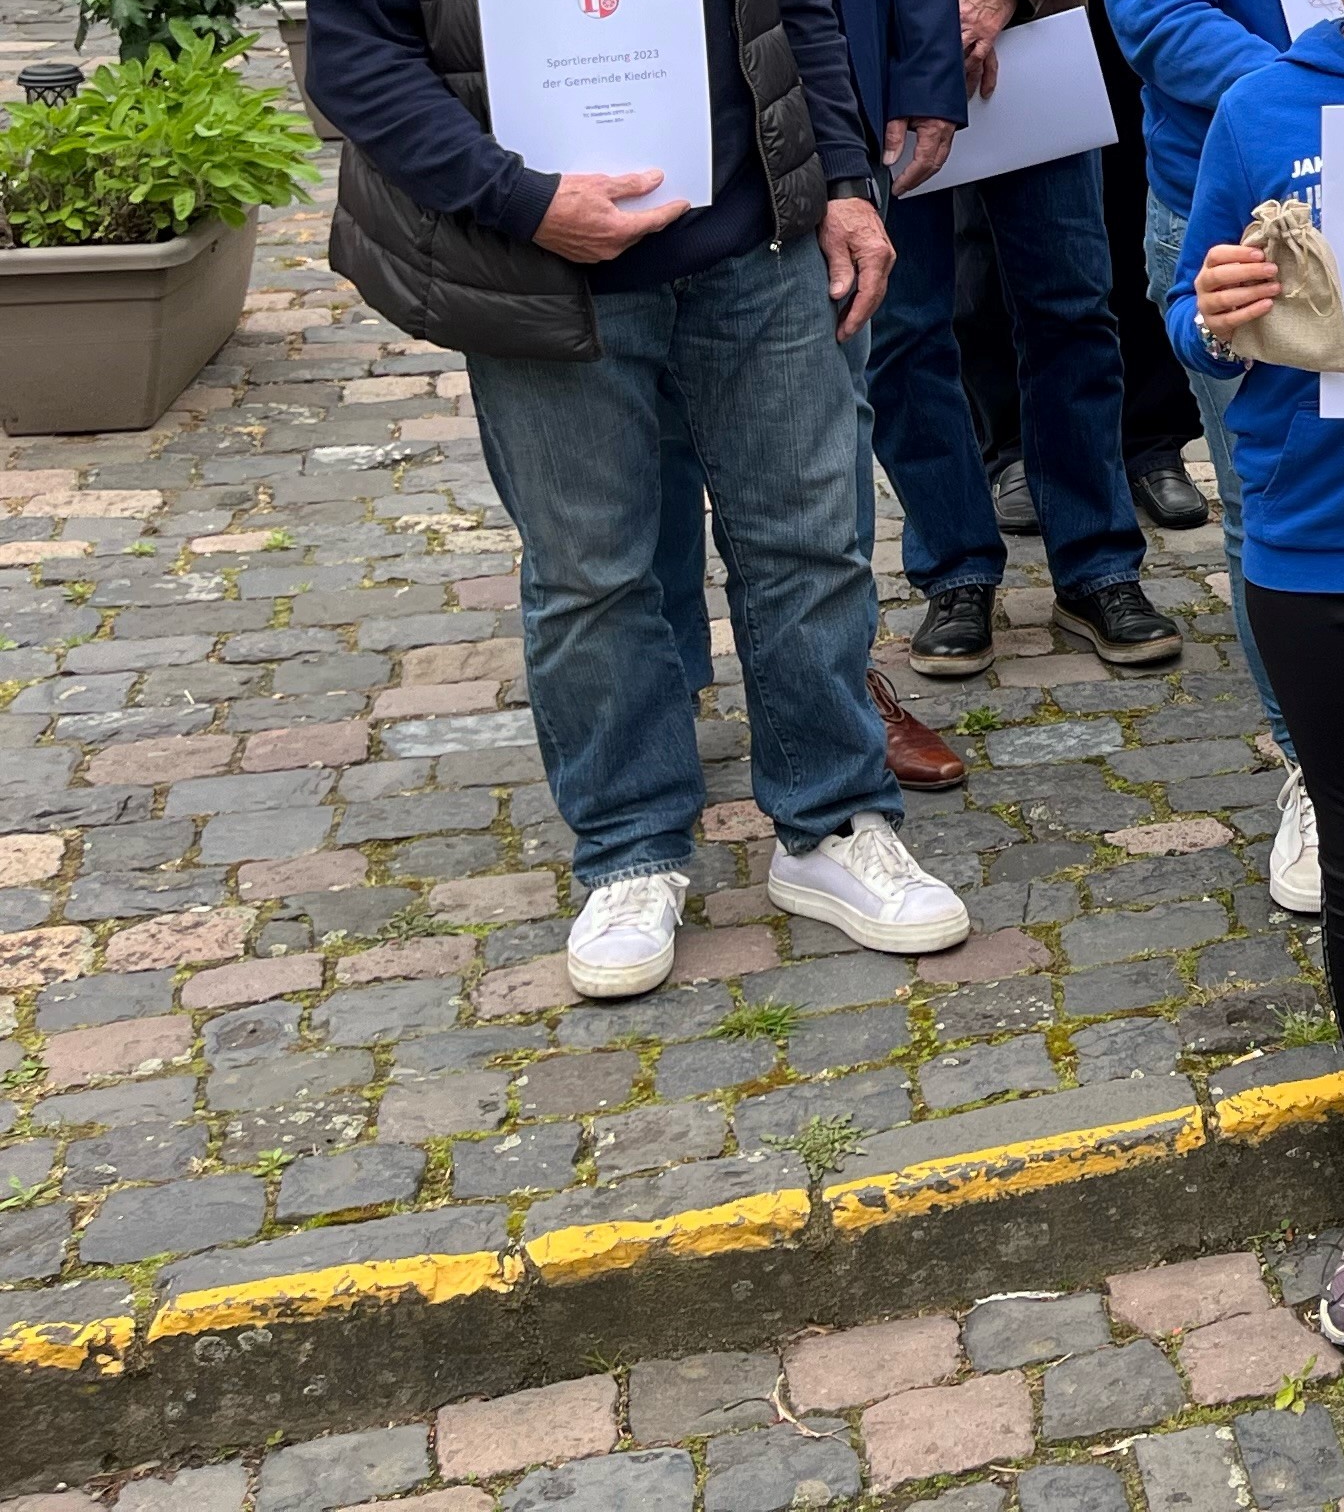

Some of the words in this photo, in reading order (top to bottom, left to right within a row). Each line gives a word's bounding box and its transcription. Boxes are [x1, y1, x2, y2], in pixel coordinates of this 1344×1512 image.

[546, 53, 631, 69] Sportlerehrung
[633, 48, 660, 61] 2023
[542, 79, 561, 89] der
[564, 73, 622, 87] Gemeinde
[624, 69, 667, 81] Kiedrich
